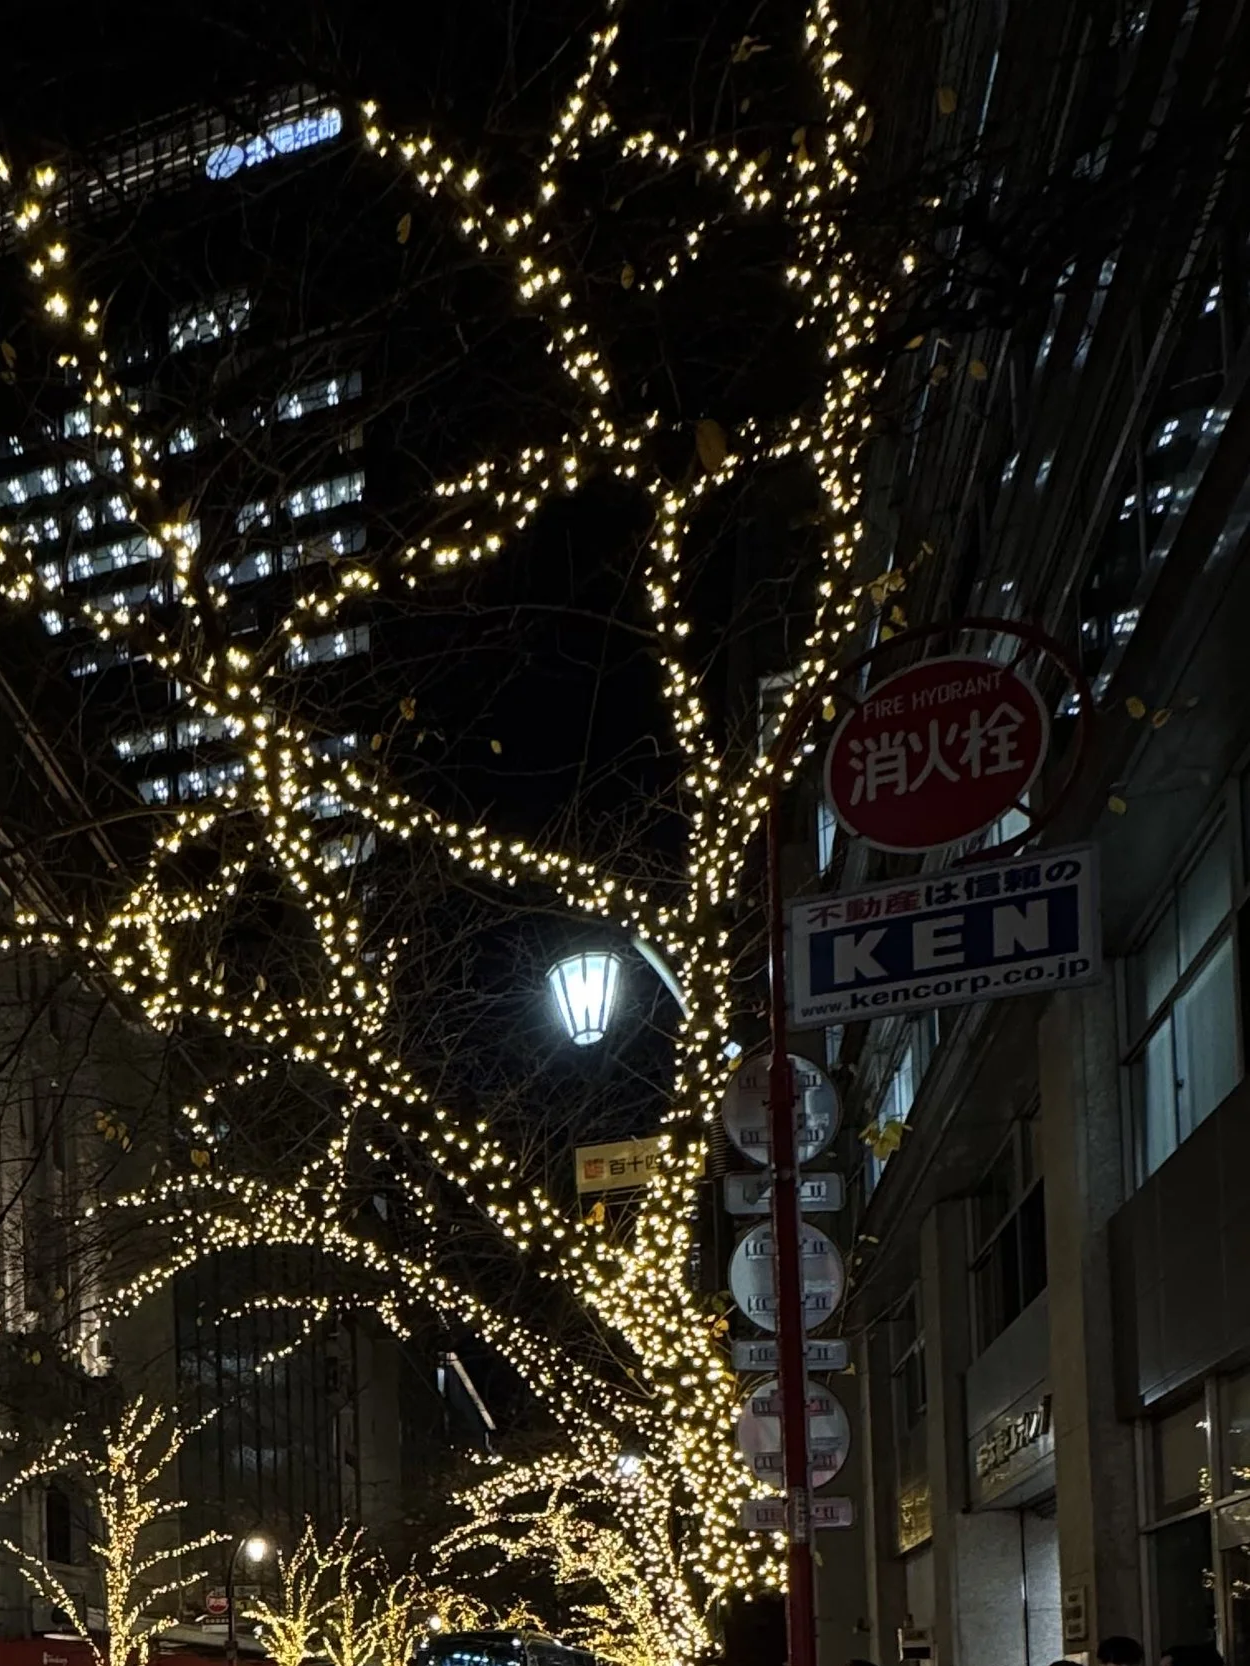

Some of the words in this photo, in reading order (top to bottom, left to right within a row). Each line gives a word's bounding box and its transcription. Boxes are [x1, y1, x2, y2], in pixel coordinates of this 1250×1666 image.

[862, 696, 905, 721] FIRE
[912, 674, 1003, 711] HYDRANT
[848, 702, 1025, 806] 消火栓
[807, 859, 1082, 928] 不動産は信頼の
[833, 899, 1049, 985] KEN
[800, 956, 1091, 1019] www.kencorp.co.jp
